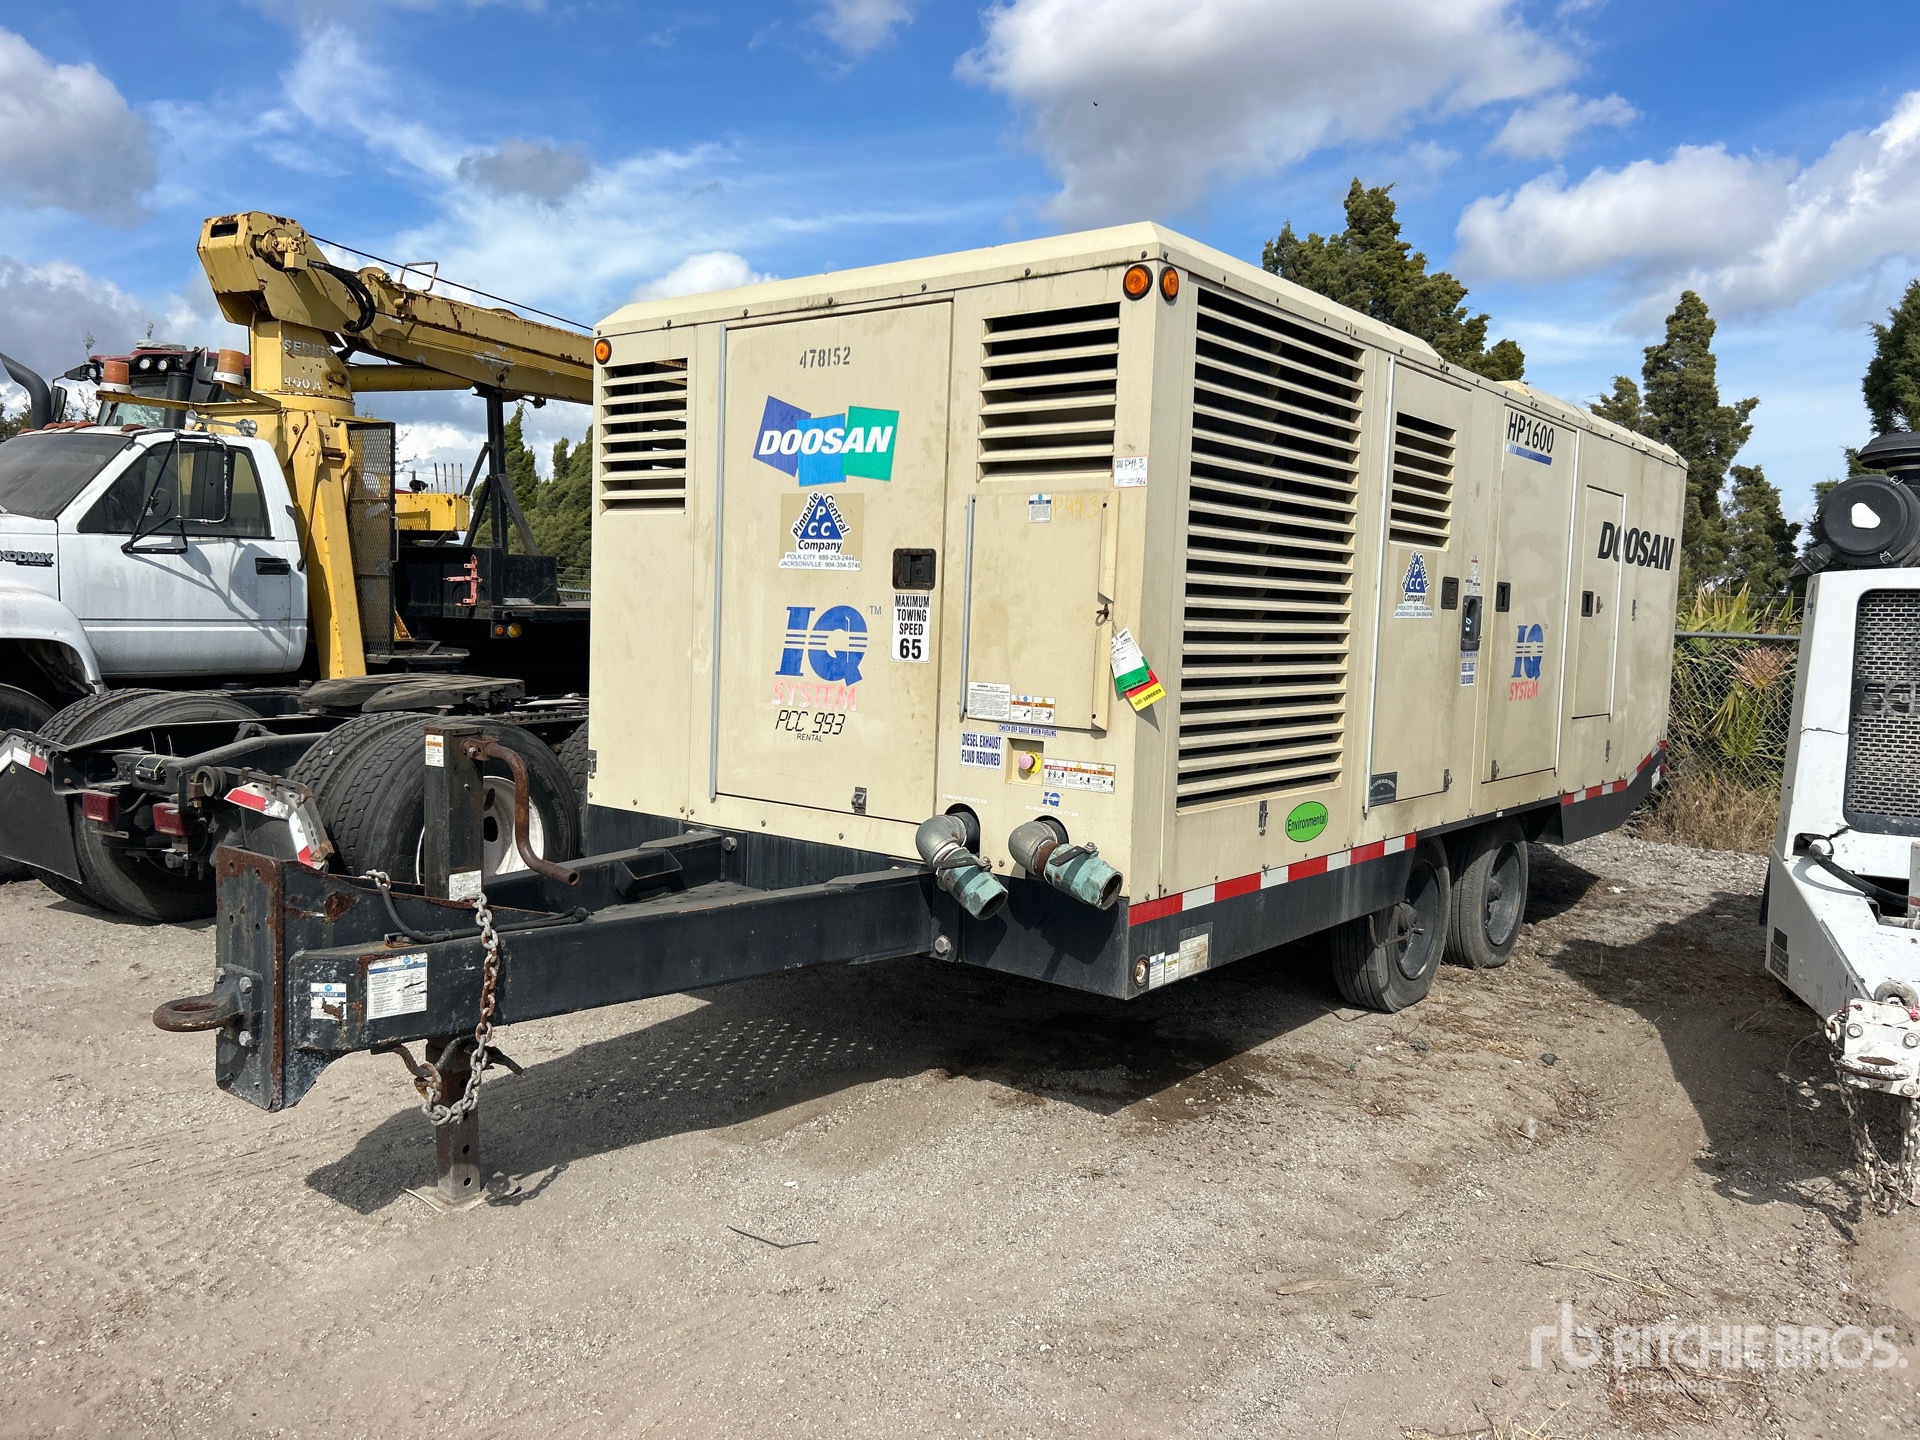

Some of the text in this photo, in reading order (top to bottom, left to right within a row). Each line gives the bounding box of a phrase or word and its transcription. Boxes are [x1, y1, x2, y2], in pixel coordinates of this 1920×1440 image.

[284, 339, 334, 358] SERIES
[800, 346, 851, 369] 478152
[758, 426, 893, 455] DOOSAN
[1507, 412, 1555, 454] HP1600
[792, 492, 820, 538] Pinnacle
[825, 495, 850, 534] Central
[798, 540, 843, 553] Company
[1597, 521, 1675, 571] DOOSAN
[895, 595, 930, 608] MAXIMUM
[897, 609, 927, 622] TOWING
[899, 623, 924, 636] SPEED
[775, 605, 868, 687] IQ
[899, 638, 922, 660] 65
[1511, 623, 1544, 680] IQ
[771, 681, 858, 712] SYSTEM
[1509, 680, 1539, 702] SYSTEM
[775, 710, 846, 735] PCC 993
[796, 733, 823, 743] RENTAL
[962, 733, 1002, 749] DIESEL EXHAUST
[1041, 792, 1061, 807] IQ
[1287, 812, 1326, 832] Environmental
